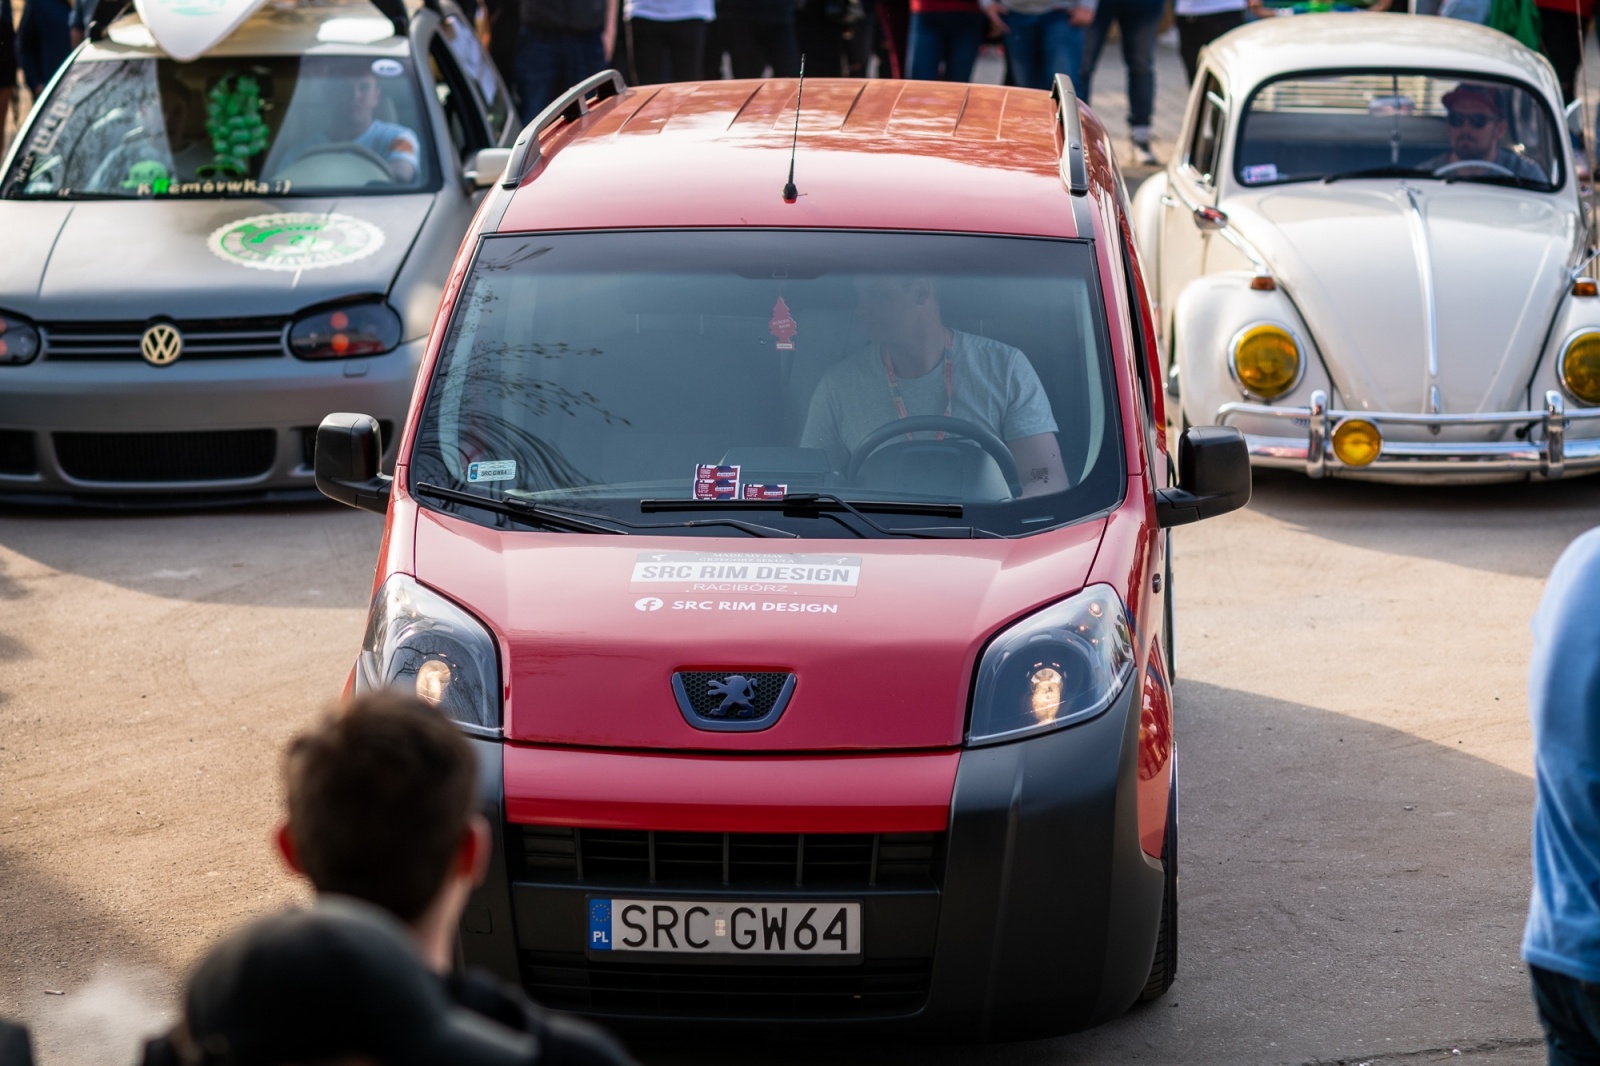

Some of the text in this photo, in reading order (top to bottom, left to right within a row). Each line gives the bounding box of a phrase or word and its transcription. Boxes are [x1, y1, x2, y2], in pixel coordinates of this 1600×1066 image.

[641, 565, 850, 582] SRC RIM DESIGN
[693, 583, 789, 593] RACIBÓRZ
[672, 601, 714, 610] SRC
[718, 601, 756, 611] RIM
[761, 602, 838, 614] DESIGN
[621, 904, 847, 951] SRC GW64
[593, 931, 609, 943] PL
